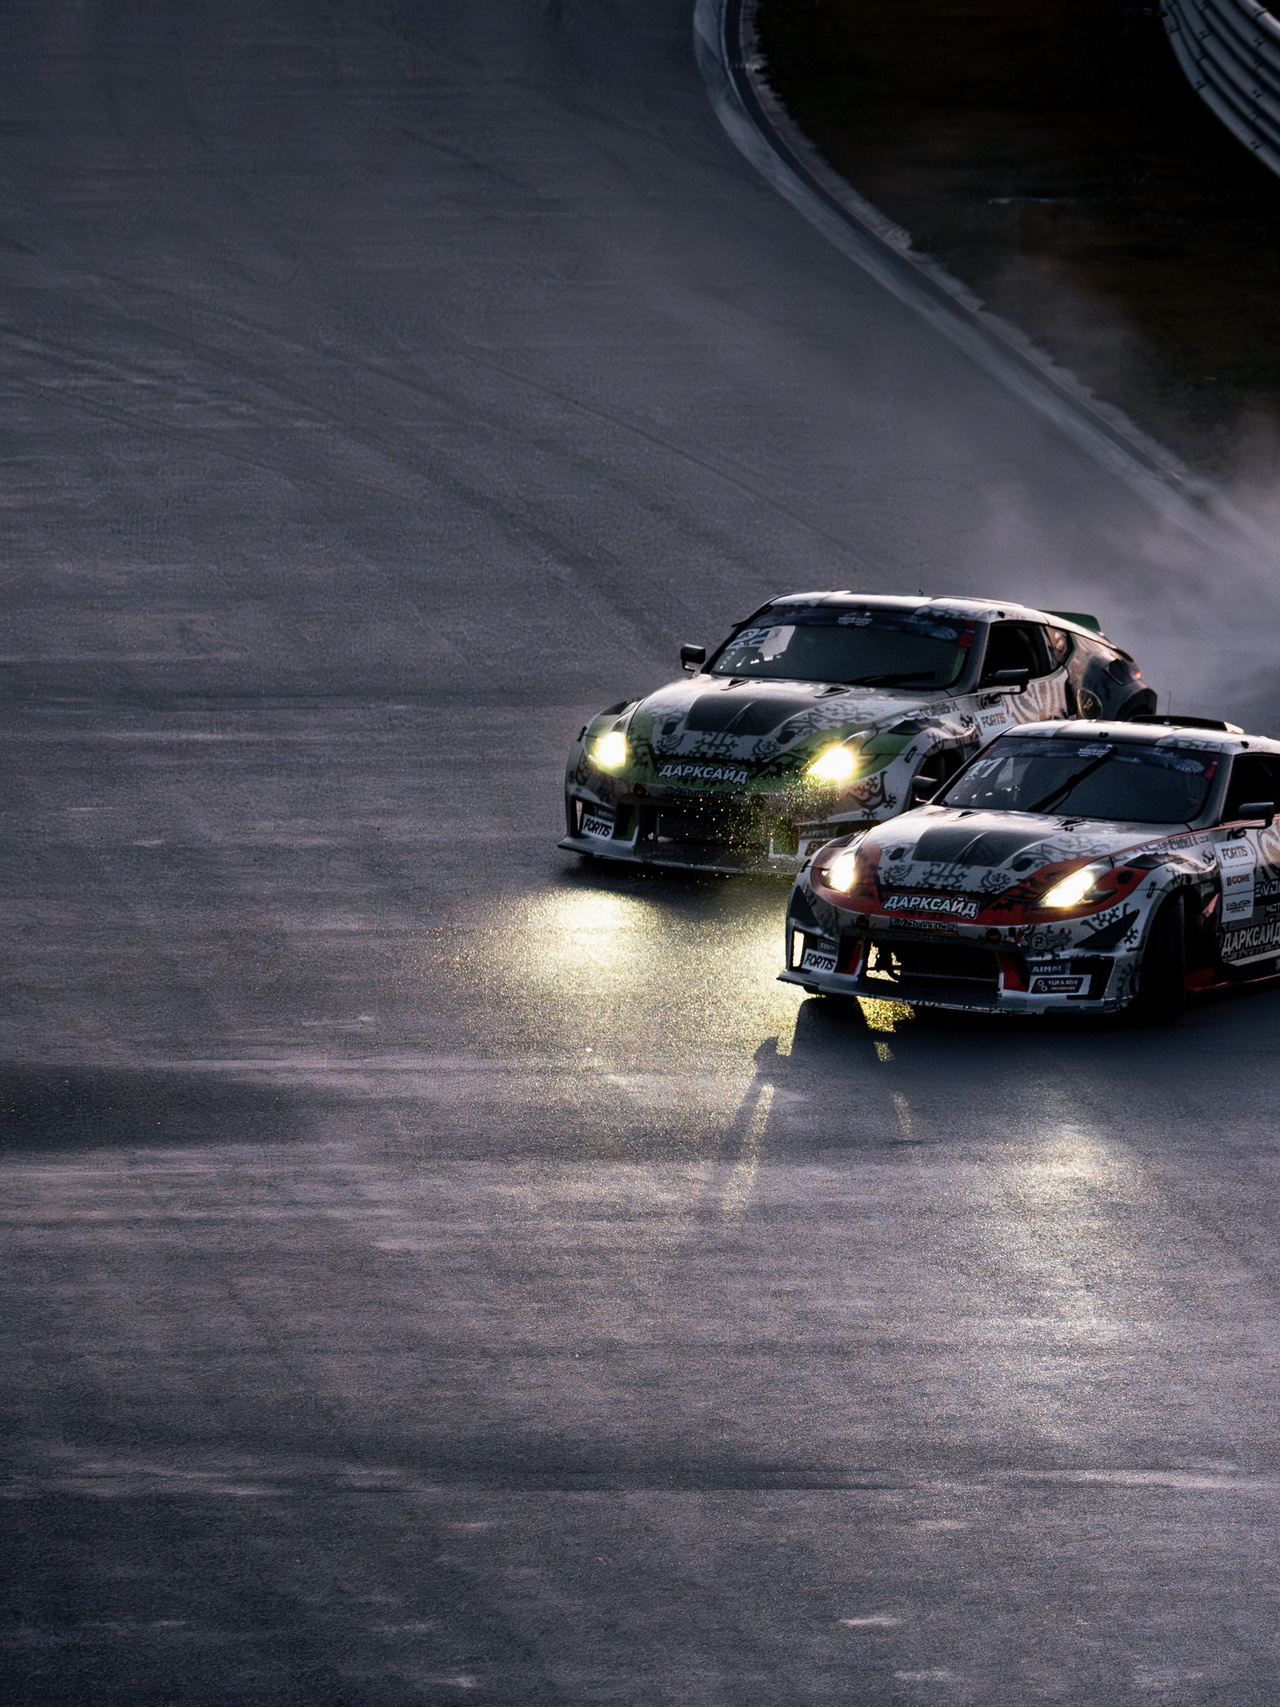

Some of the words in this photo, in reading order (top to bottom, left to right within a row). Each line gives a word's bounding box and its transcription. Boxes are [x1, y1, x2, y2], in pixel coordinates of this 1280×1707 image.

[980, 713, 1007, 728] FORTIS
[657, 764, 749, 785] ДАРКСАЙД
[583, 818, 612, 838] FORTIS
[1221, 845, 1248, 860] FORTIS
[884, 895, 978, 917] ДАРКСАЙД
[804, 953, 836, 971] FORTIS
